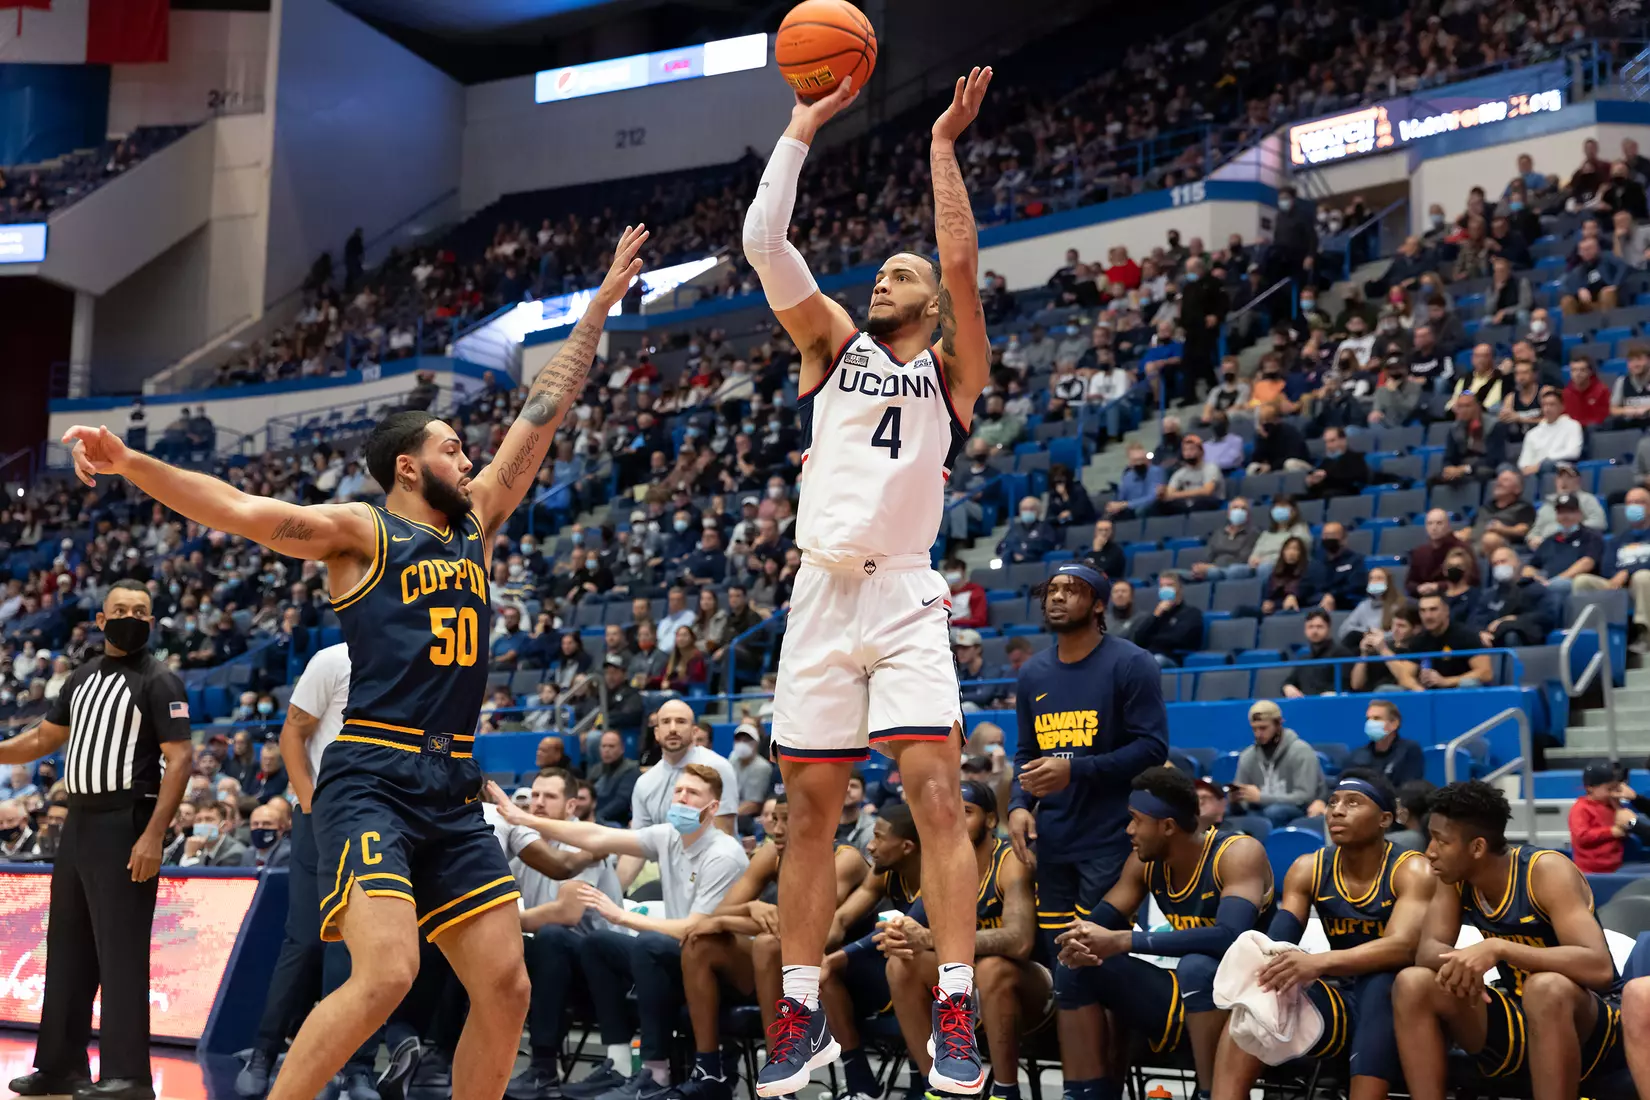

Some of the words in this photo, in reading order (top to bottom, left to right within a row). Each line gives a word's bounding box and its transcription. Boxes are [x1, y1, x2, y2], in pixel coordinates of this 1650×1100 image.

[615, 127, 646, 149] 212
[1170, 181, 1206, 206] 115
[839, 368, 937, 399] UCONN
[871, 406, 902, 460] 4
[400, 557, 487, 606] COPPIN
[429, 607, 478, 667] 50
[1034, 709, 1099, 734] ALWAYS
[361, 831, 383, 866] C
